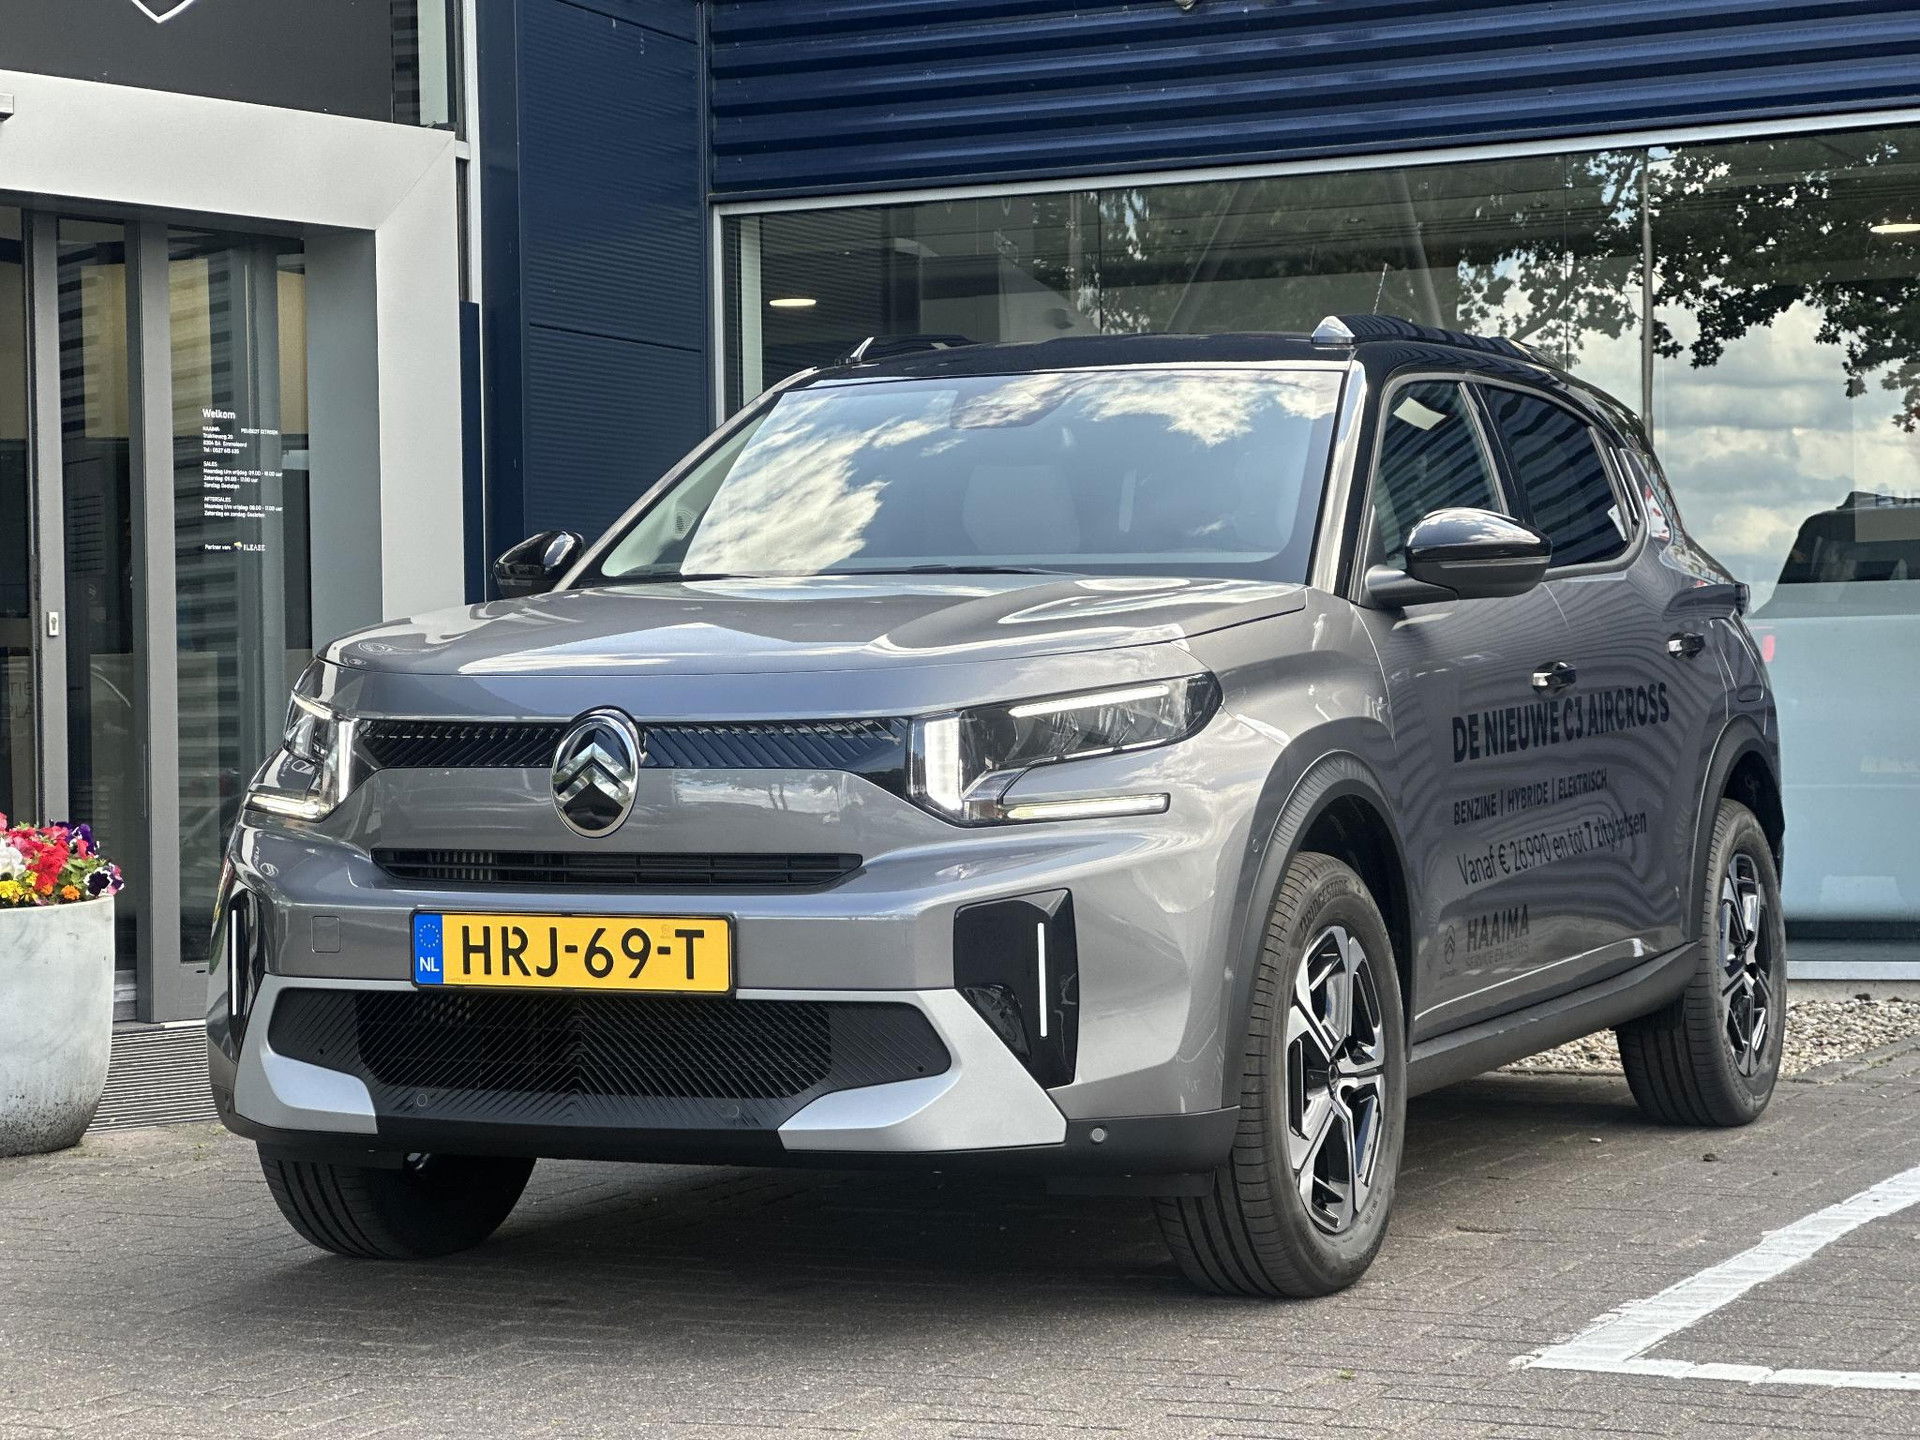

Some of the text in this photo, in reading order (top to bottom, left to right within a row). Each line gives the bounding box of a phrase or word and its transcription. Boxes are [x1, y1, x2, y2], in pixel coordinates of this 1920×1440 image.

[202, 409, 236, 419] Welkom
[204, 503, 224, 511] Maandag
[1452, 682, 1670, 763] DE NIEUWE C3 AIRCROSS
[1453, 793, 1497, 825] BENZINE
[1507, 781, 1548, 812] HYBRIDE
[1558, 768, 1608, 800] ELEKTRISCH
[1456, 811, 1646, 886] Vanaf € 26.990 en tot 7 zitplaatsen
[462, 925, 705, 980] HRJ-69-T
[1467, 904, 1530, 952] HAAIMA
[419, 956, 440, 972] NL
